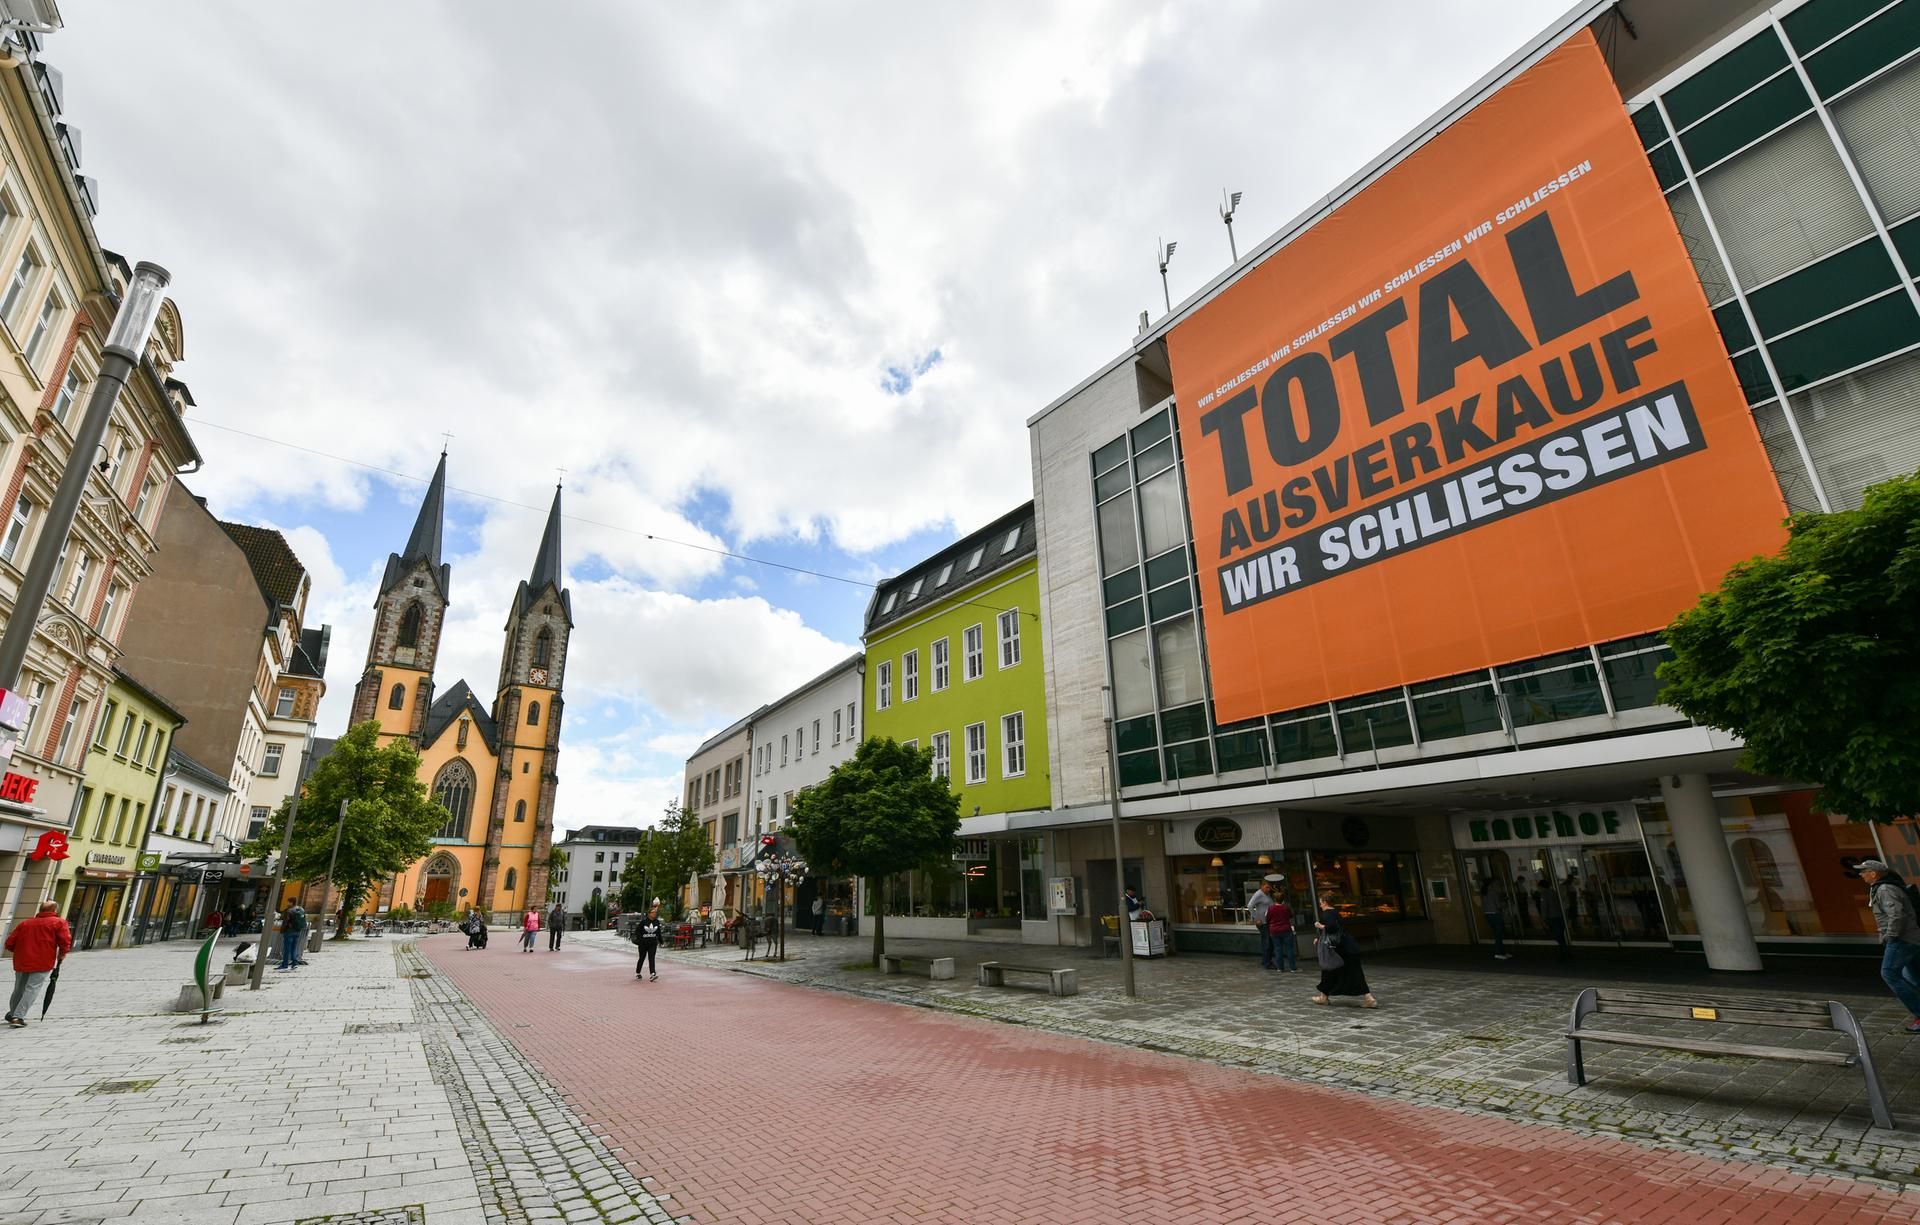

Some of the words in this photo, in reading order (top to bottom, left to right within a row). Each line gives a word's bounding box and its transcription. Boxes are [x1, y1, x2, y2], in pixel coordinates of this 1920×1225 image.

[1197, 392, 1214, 408] WIR
[1215, 358, 1269, 396] SCHLIESSEN
[1271, 345, 1290, 363] WIR
[1292, 304, 1357, 349] SCHLIESSEN
[1358, 288, 1382, 309] WIR
[1384, 239, 1462, 293] SCHLIESSEN
[1463, 220, 1493, 244] WIR
[1495, 159, 1592, 225] SCHLIESSEN
[1200, 210, 1640, 496] TOTAL
[1219, 315, 1659, 559] AUSVERKAUF
[1222, 546, 1301, 606] WIR
[1318, 394, 1691, 571] SCHLIESSEN
